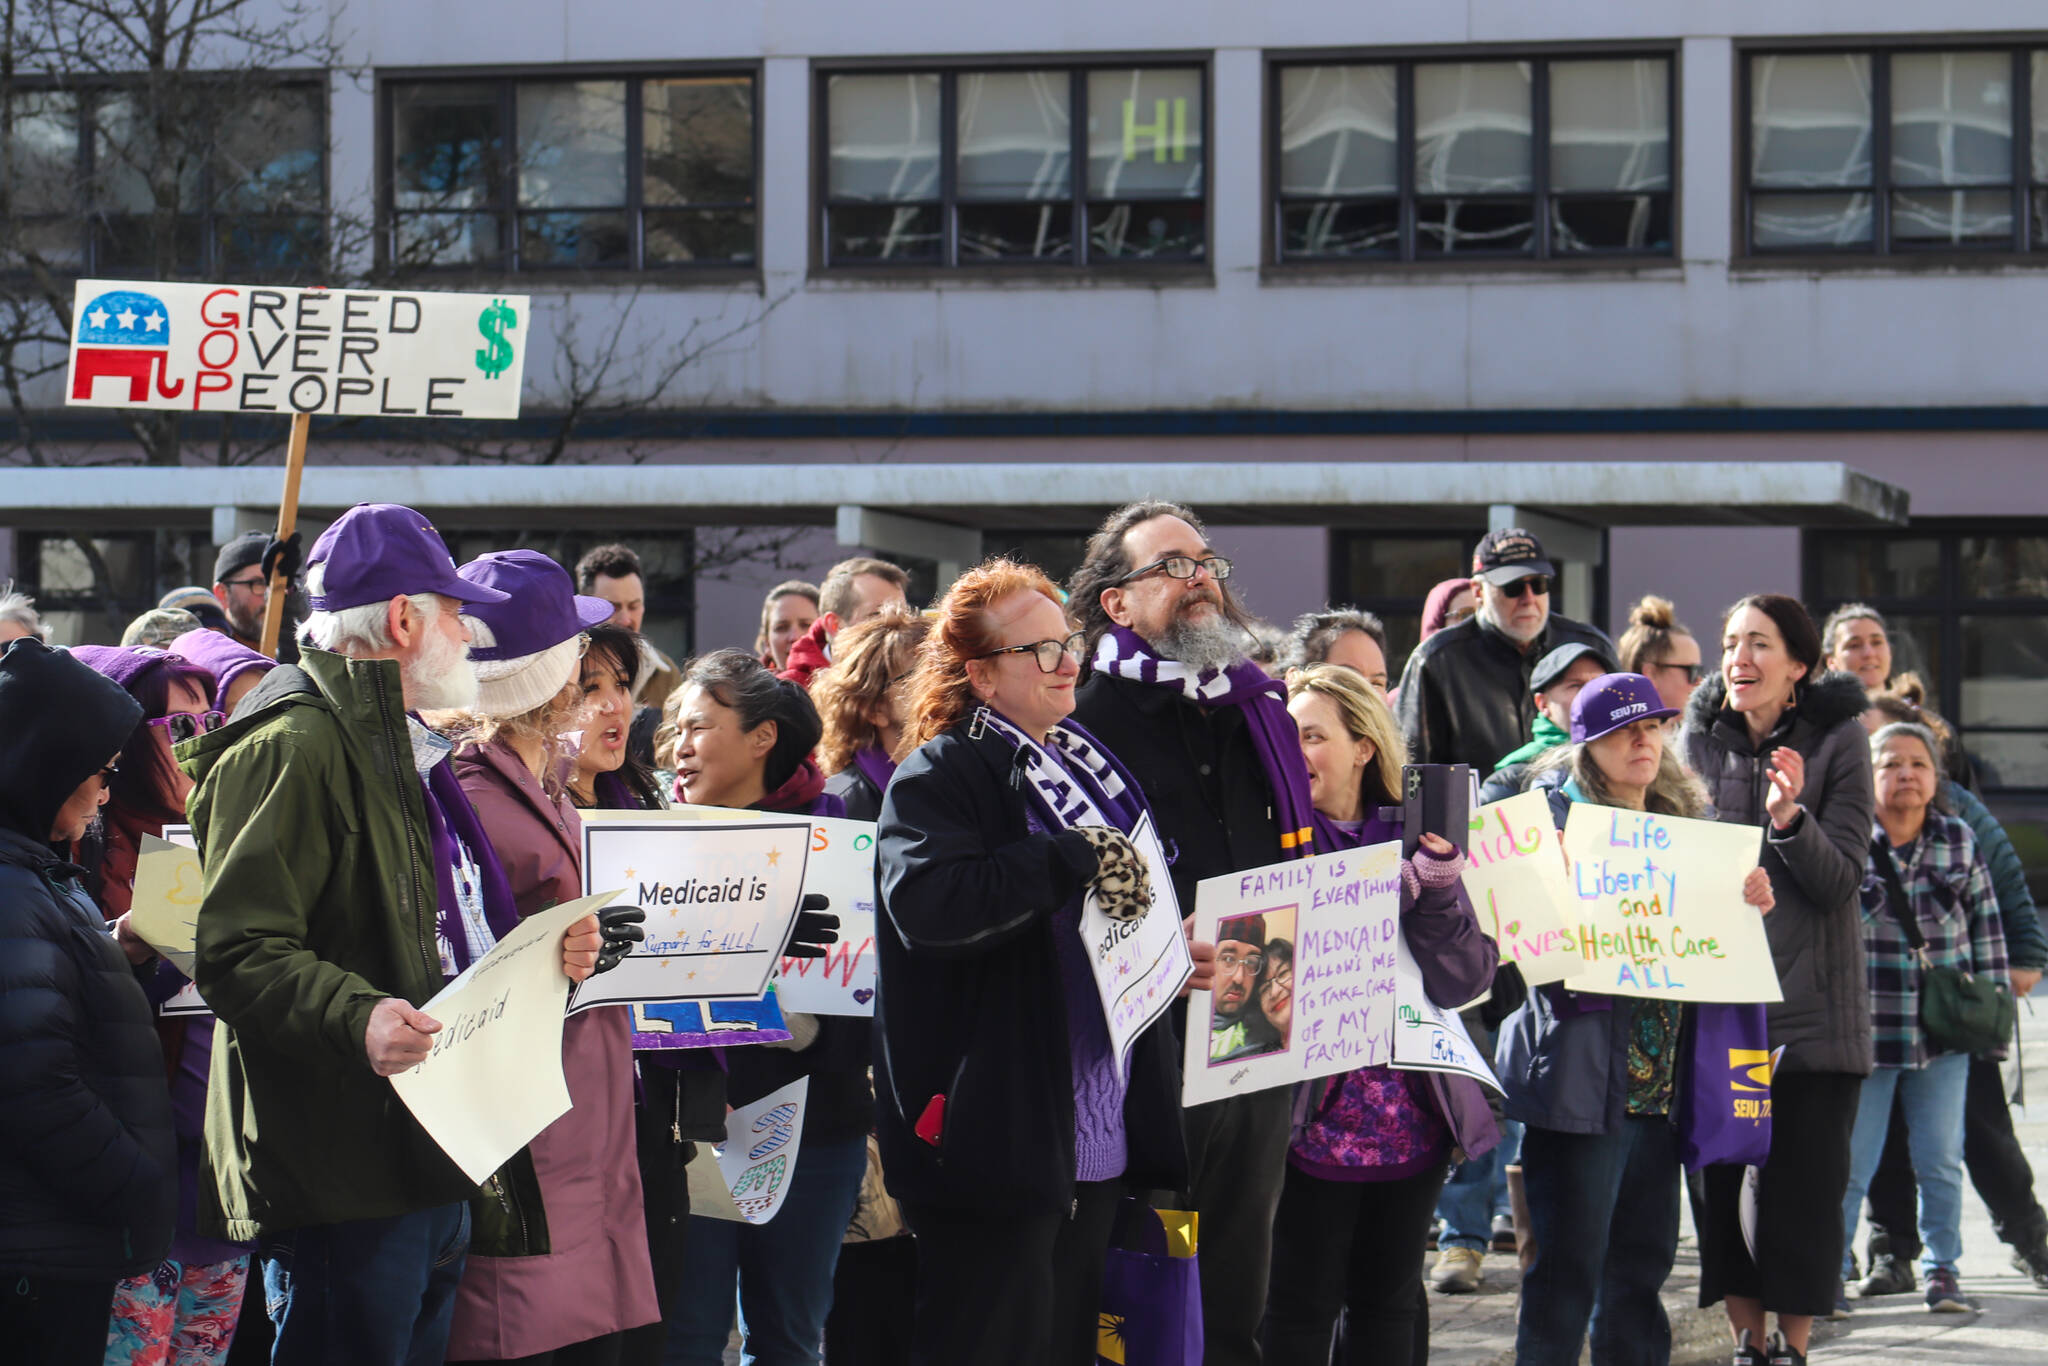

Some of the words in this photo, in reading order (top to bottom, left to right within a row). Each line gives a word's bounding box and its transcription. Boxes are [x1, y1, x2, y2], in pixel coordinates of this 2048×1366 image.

[1122, 97, 1186, 163] HI
[200, 288, 422, 334] GREED
[198, 329, 380, 375] OVER
[193, 370, 466, 416] PEOPLE
[1610, 705, 1631, 721] SEIU
[1631, 702, 1648, 714] 775
[1038, 779, 1090, 826] AL
[1609, 810, 1671, 849] Life
[638, 876, 744, 906] Medicaid
[749, 876, 768, 901] is
[1240, 863, 1316, 898] FAMILY
[1329, 860, 1346, 877] IS
[1575, 857, 1676, 917] Liberty
[1619, 894, 1662, 917] and
[640, 934, 690, 955] Support
[697, 930, 717, 951] for
[1301, 918, 1395, 960] MEDICAID
[1579, 923, 1666, 960] Health
[1671, 926, 1726, 959] Care
[1373, 953, 1396, 970] ME
[1617, 963, 1685, 989] ALL
[1320, 985, 1363, 1007] TAKE
[1366, 977, 1396, 998] CARE
[416, 987, 511, 1073] edicaid
[1301, 1019, 1323, 1042] OF
[1338, 1006, 1371, 1036] MY
[1733, 1099, 1759, 1119] SEIU
